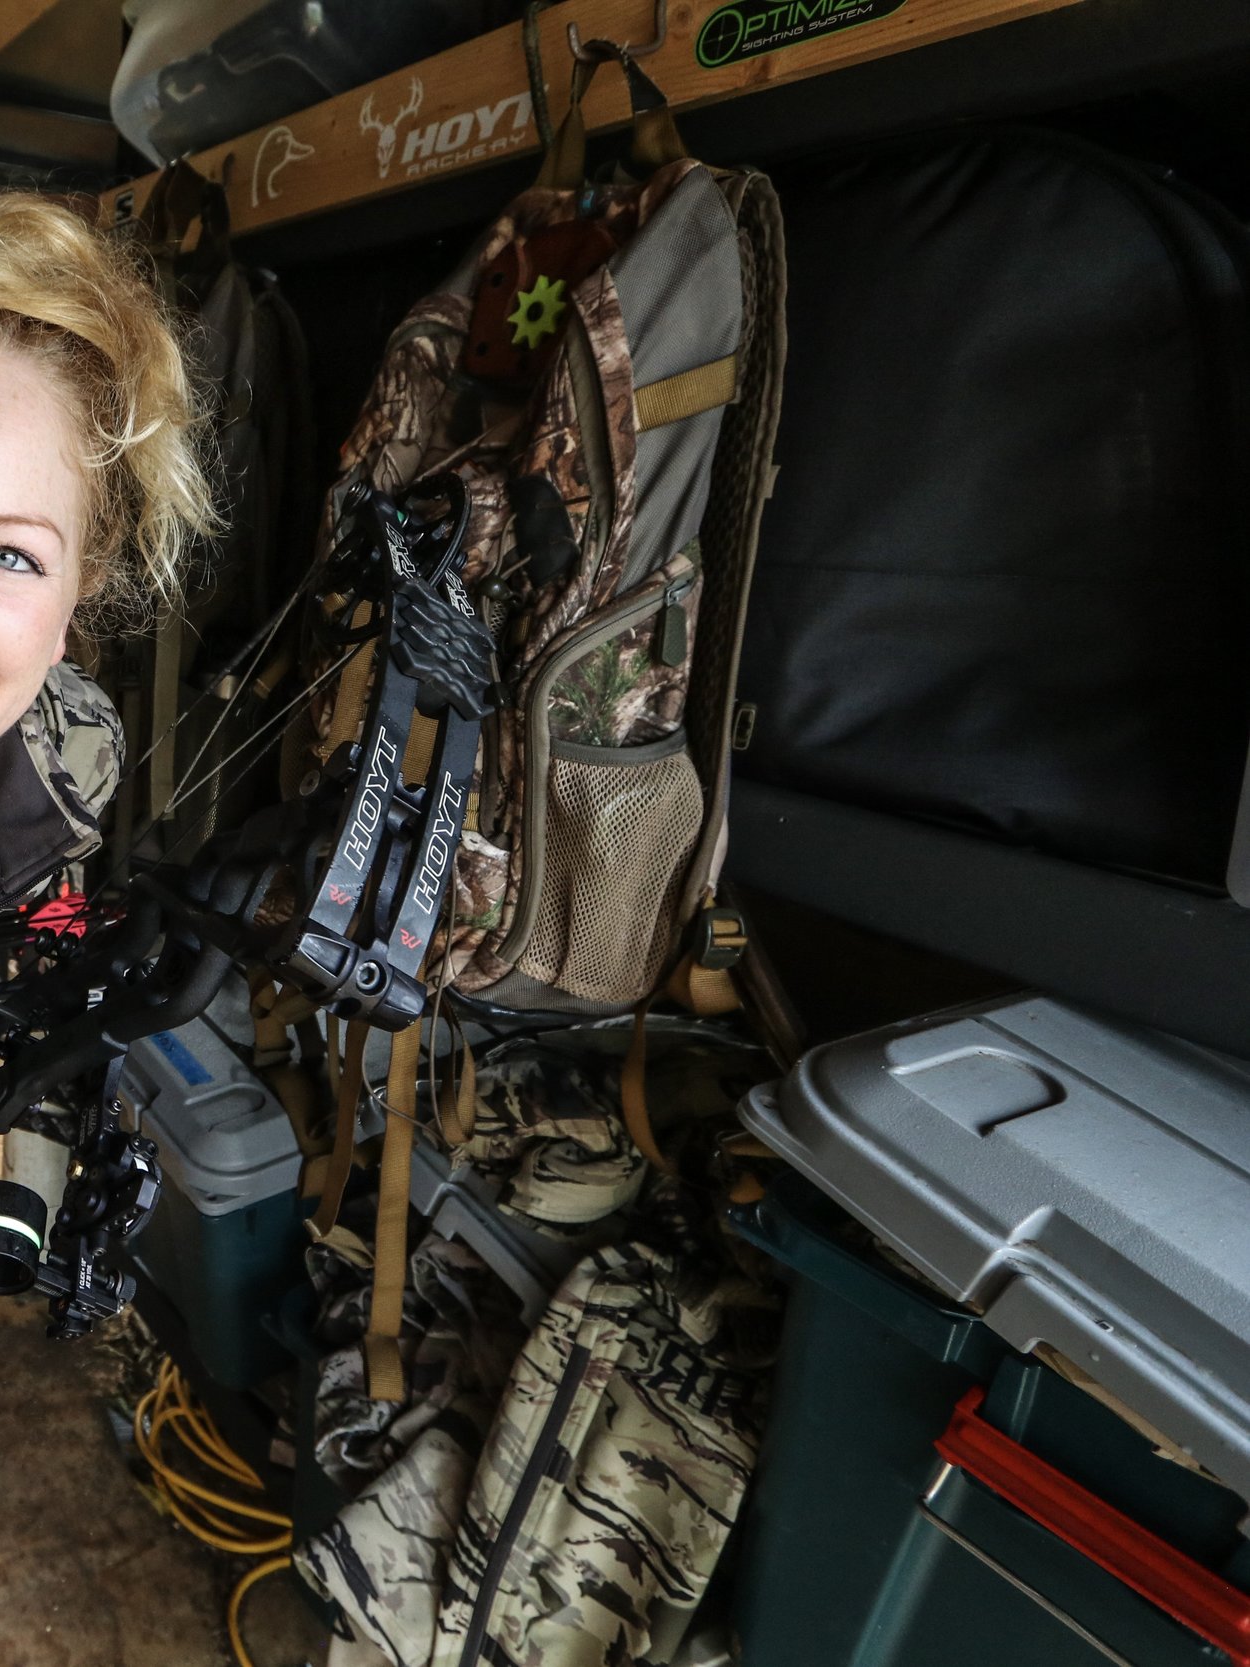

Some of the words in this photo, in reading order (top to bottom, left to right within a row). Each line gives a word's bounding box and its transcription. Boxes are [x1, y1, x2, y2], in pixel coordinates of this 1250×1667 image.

[742, 25, 804, 51] SIGHTING
[809, 4, 873, 31] SYSTEM
[401, 85, 548, 164] HOYT
[407, 131, 526, 177] ARCHERY
[343, 725, 397, 870] HOYT
[414, 771, 463, 914] HOYT
